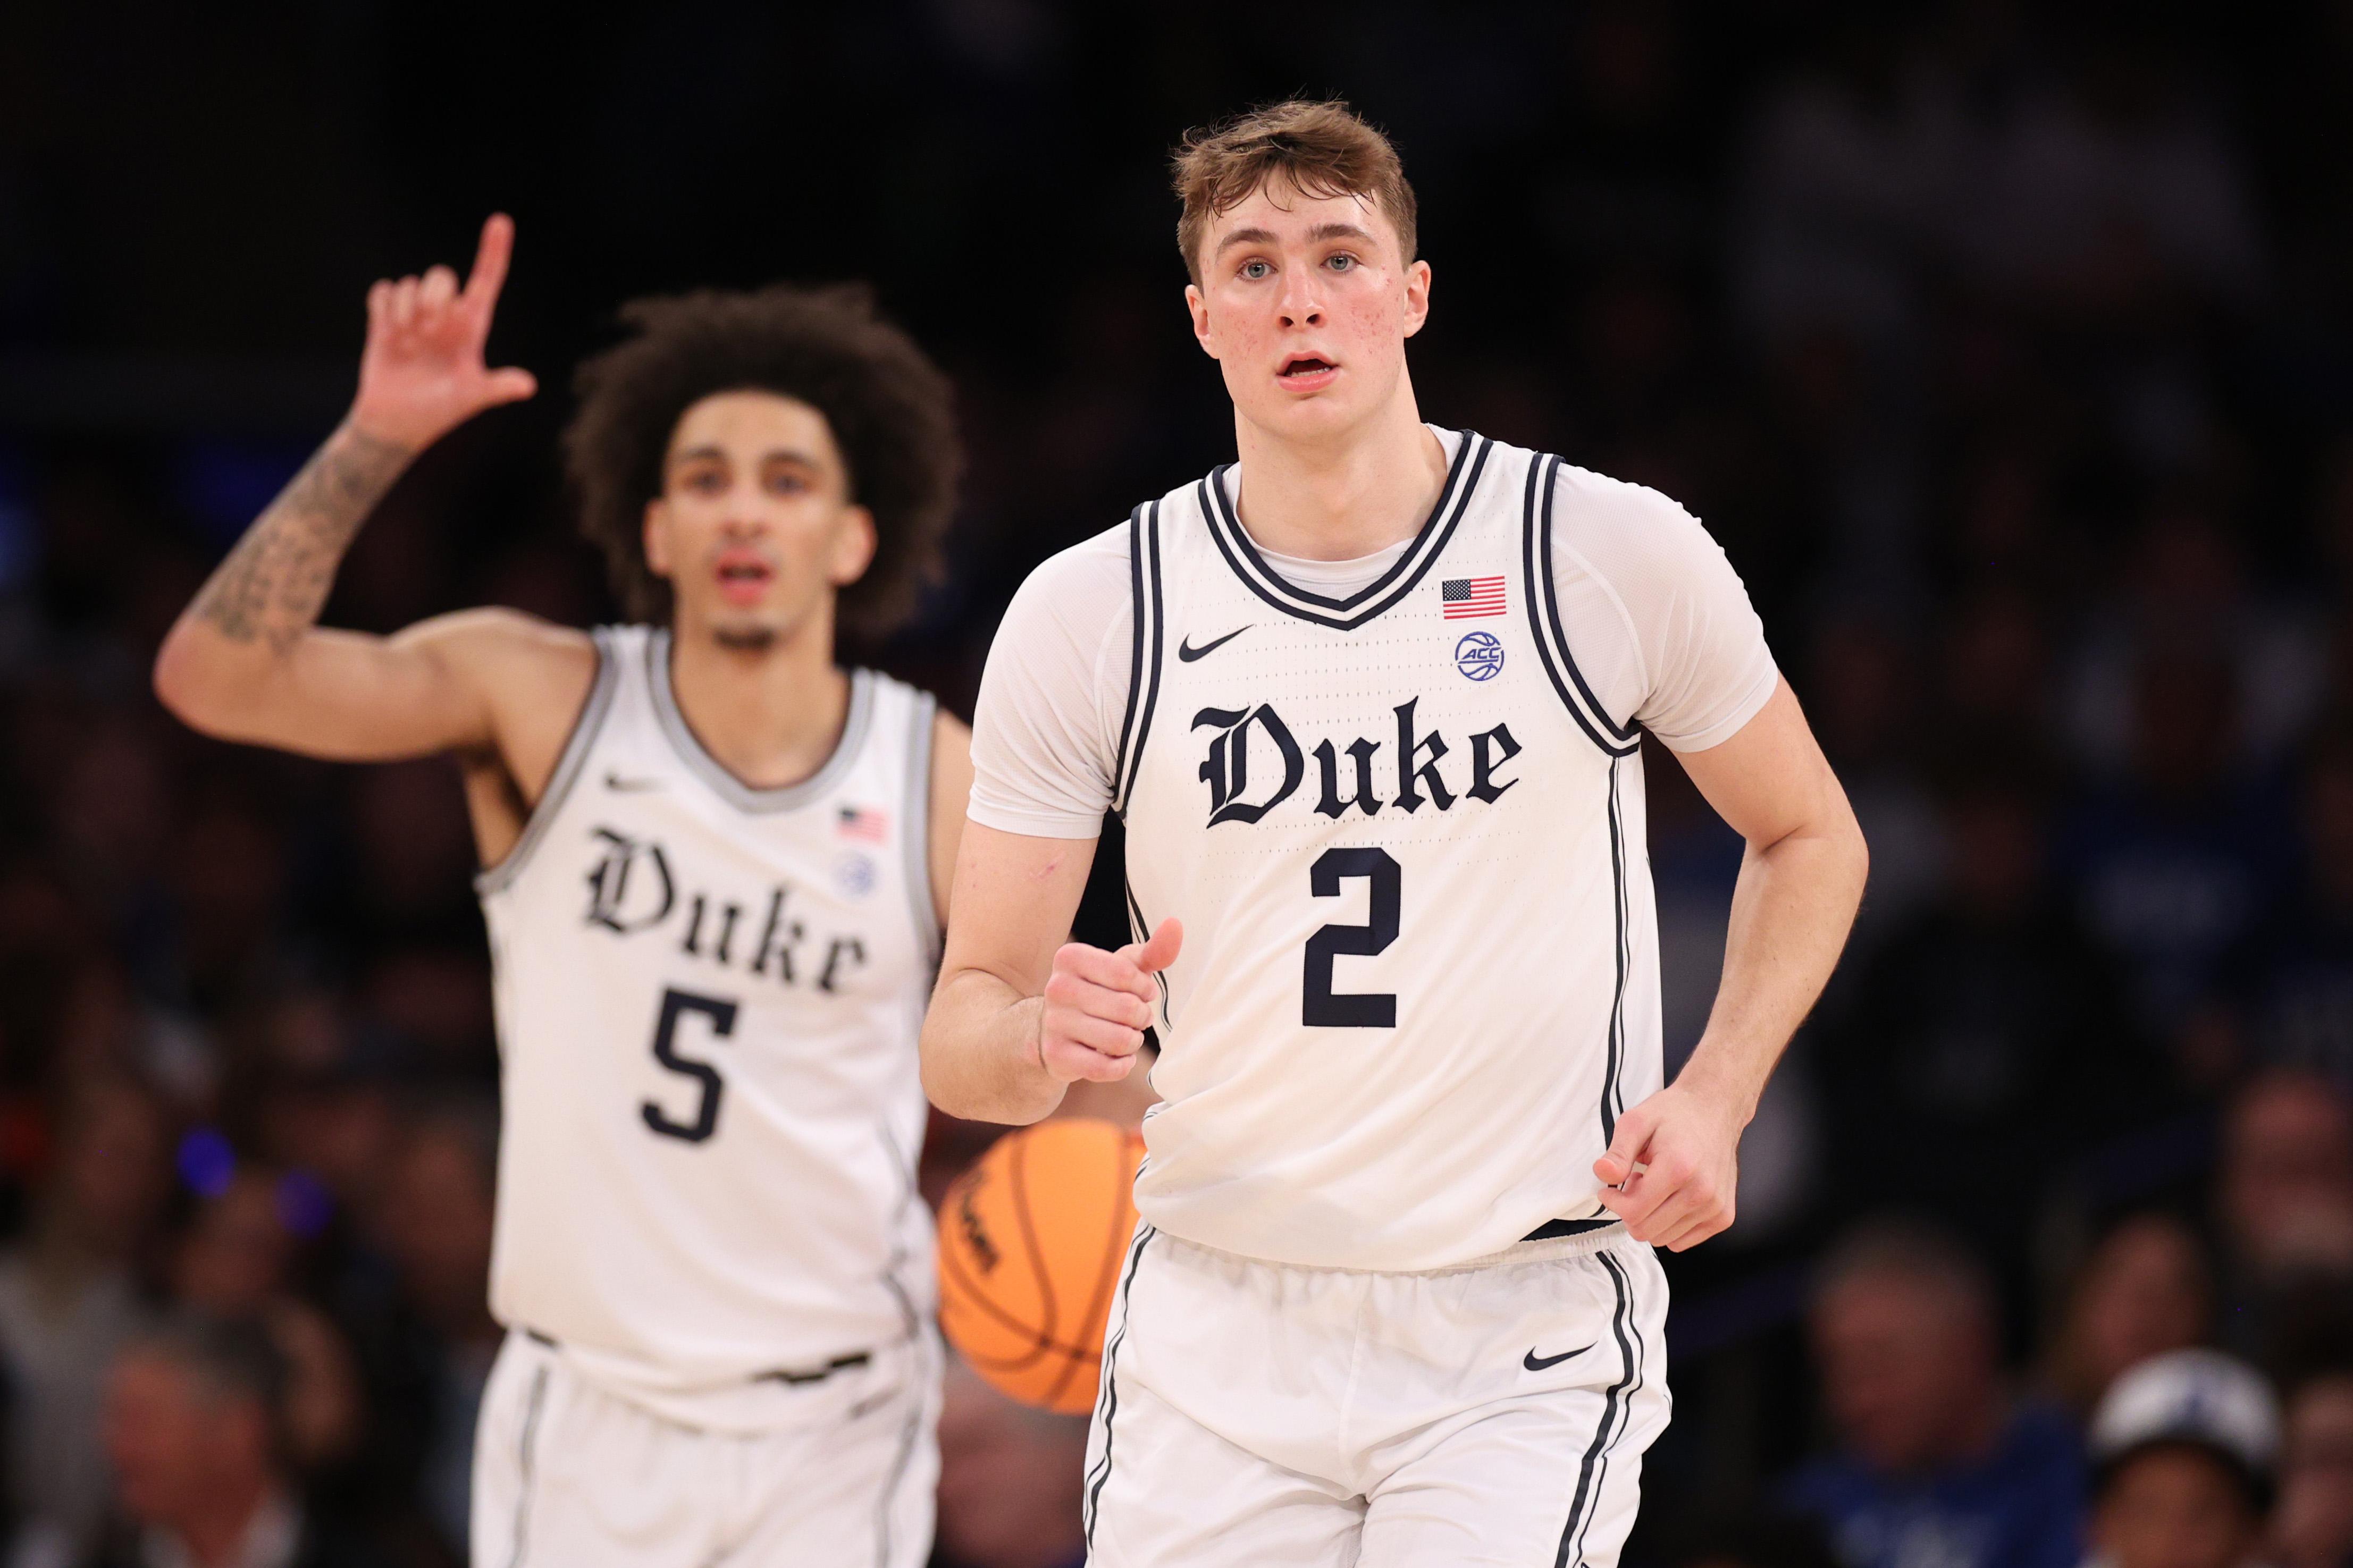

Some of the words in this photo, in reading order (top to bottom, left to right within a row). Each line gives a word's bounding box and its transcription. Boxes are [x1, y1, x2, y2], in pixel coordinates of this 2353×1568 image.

[1461, 647, 1501, 660] ACC
[1191, 695, 1522, 829] Duke
[585, 824, 868, 993] Duke
[1302, 847, 1401, 1027] 2
[641, 987, 738, 1143] 5
